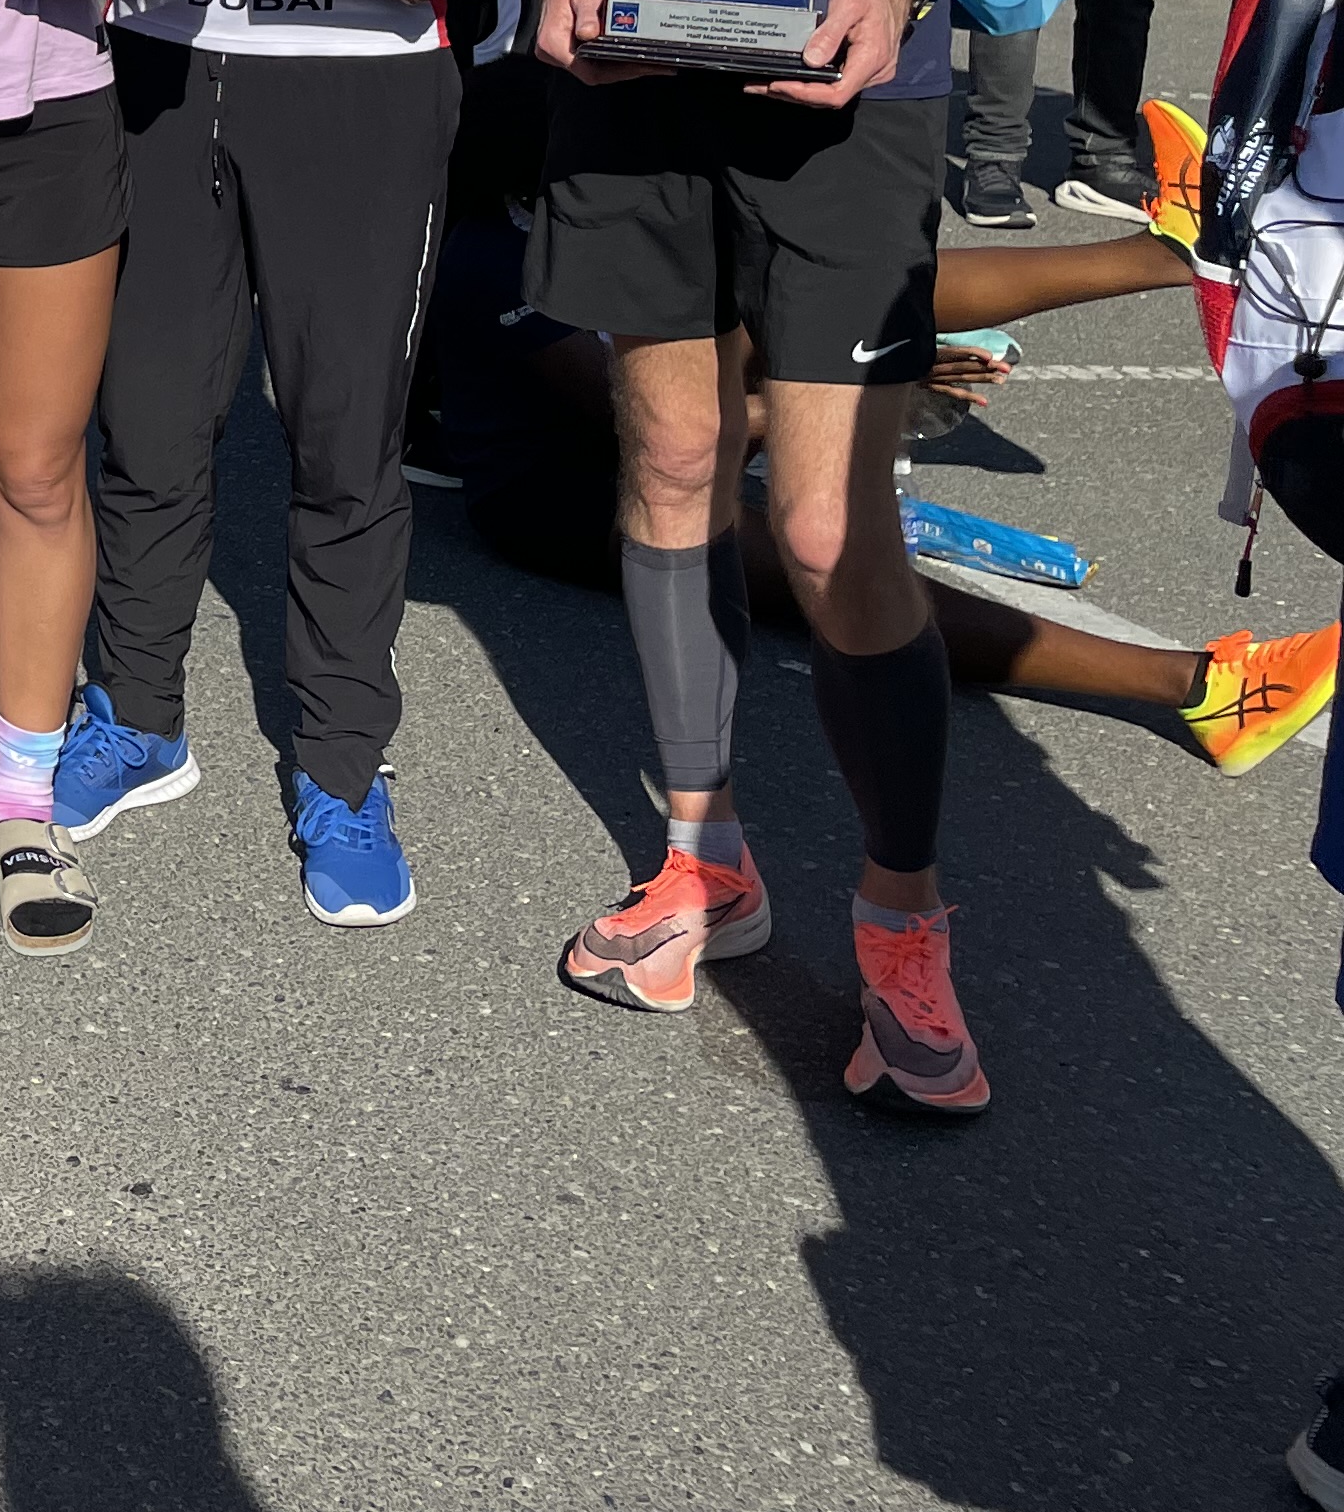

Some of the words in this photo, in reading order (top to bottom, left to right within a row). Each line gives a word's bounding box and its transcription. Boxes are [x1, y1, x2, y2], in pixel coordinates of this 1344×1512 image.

[719, 9, 740, 17] Place
[668, 13, 691, 22] Men's
[691, 15, 714, 23] Grand
[714, 17, 744, 26] Masters
[745, 19, 779, 29] Category
[659, 22, 685, 30] Marina
[686, 23, 709, 32] Home
[710, 25, 733, 34] Dubai
[733, 27, 755, 36] Creek
[756, 29, 787, 38] Striders
[702, 34, 739, 43] Marathon
[739, 36, 758, 44] 2023
